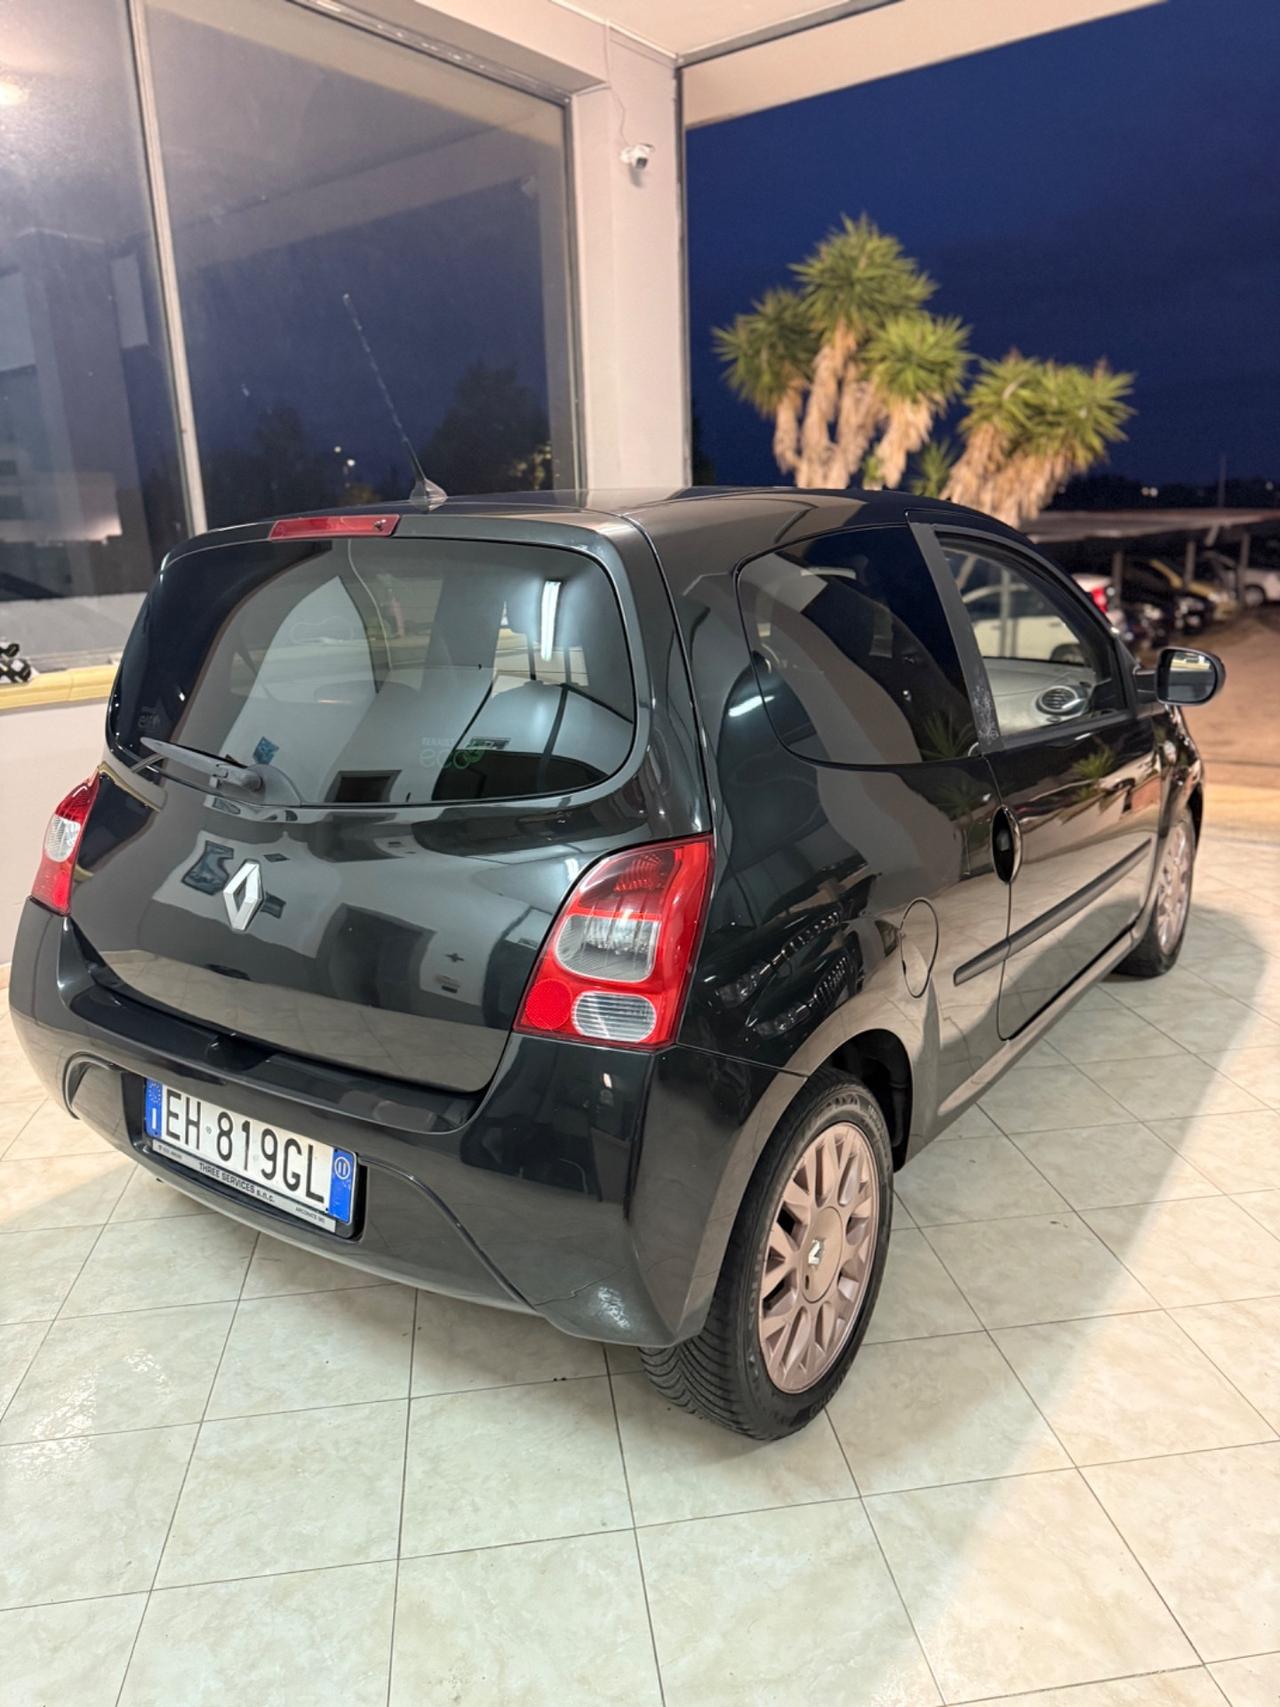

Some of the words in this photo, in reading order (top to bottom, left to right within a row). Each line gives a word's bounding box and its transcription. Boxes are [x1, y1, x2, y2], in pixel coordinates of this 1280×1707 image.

[166, 1088, 202, 1150] EH
[216, 1111, 325, 1204] 819GL
[198, 1162, 221, 1184] THREE
[221, 1173, 256, 1195] SERVICES
